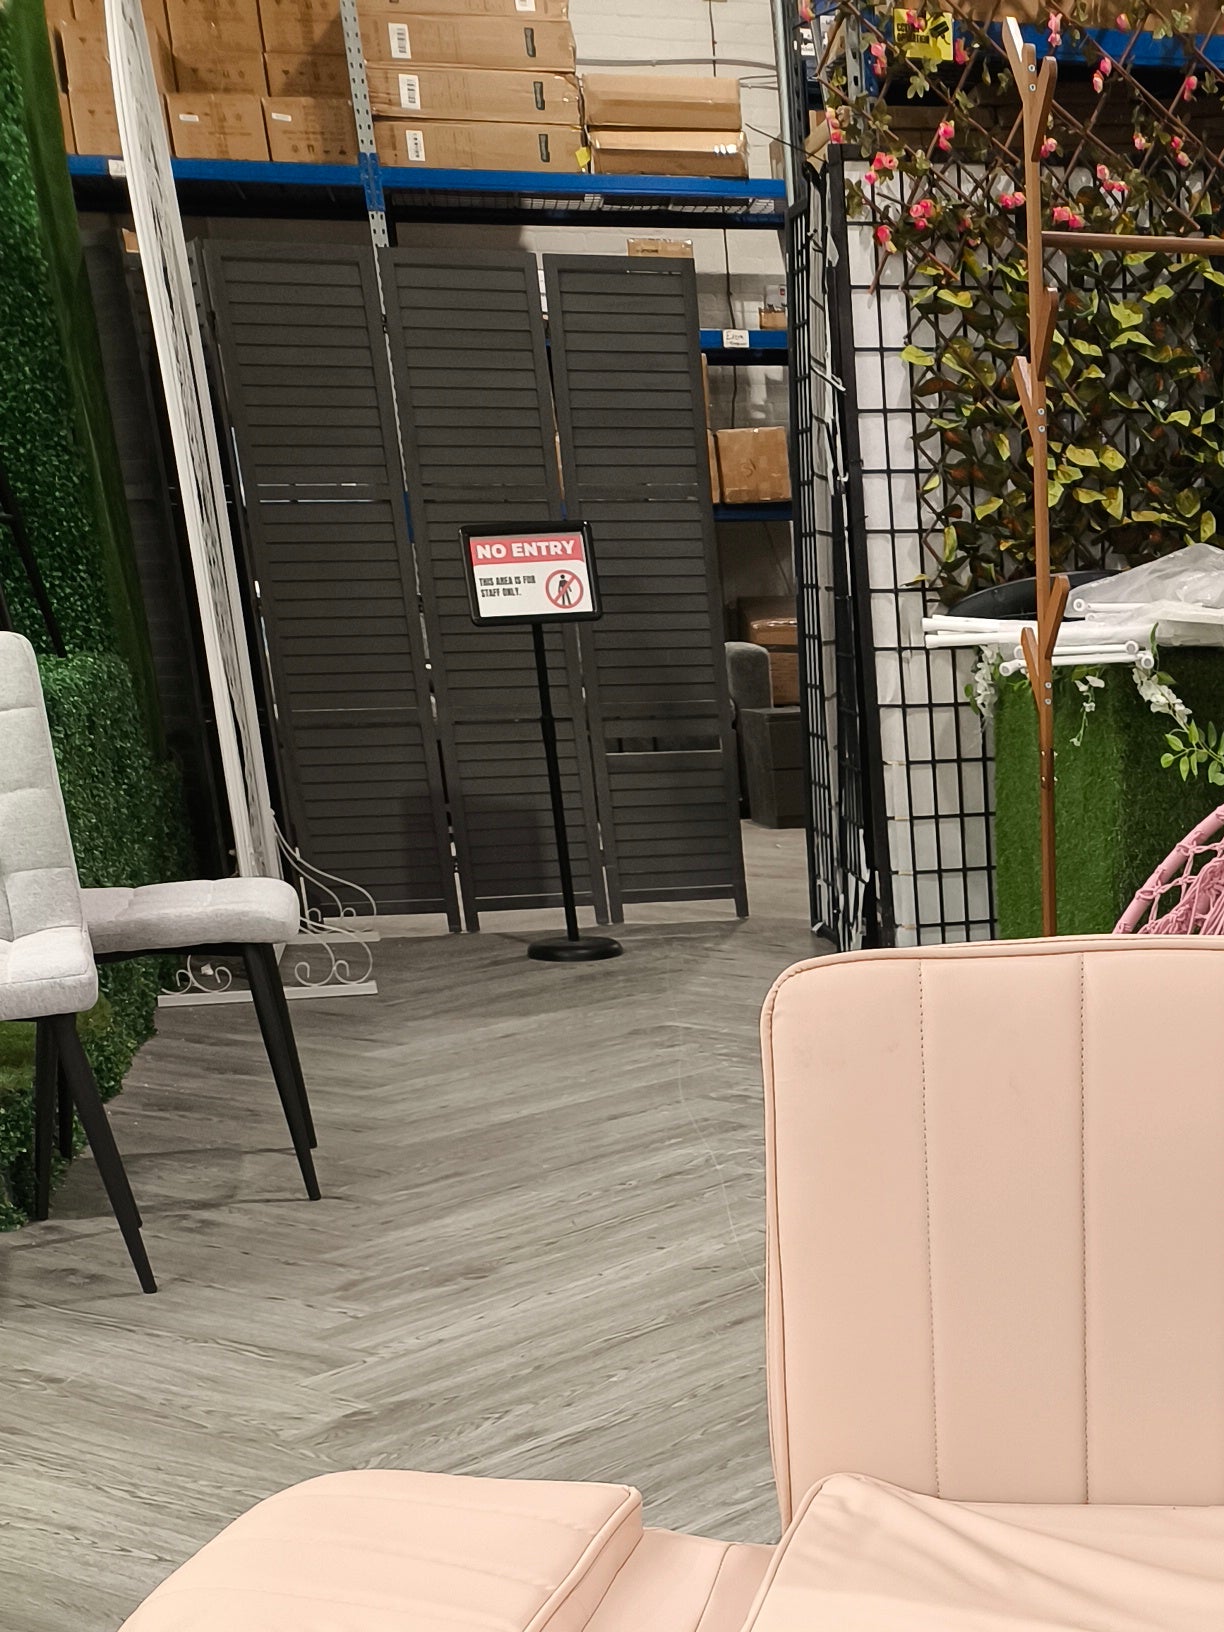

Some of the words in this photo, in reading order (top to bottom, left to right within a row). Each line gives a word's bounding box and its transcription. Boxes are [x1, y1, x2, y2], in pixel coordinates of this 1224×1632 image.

[477, 543, 506, 559] NO
[511, 540, 575, 557] ENTRY
[479, 577, 494, 587] THIS
[496, 576, 513, 585] AREA
[515, 576, 522, 584] IS
[523, 575, 536, 584] FOR
[481, 588, 501, 598] STAFF
[502, 587, 522, 596] ONLY.
